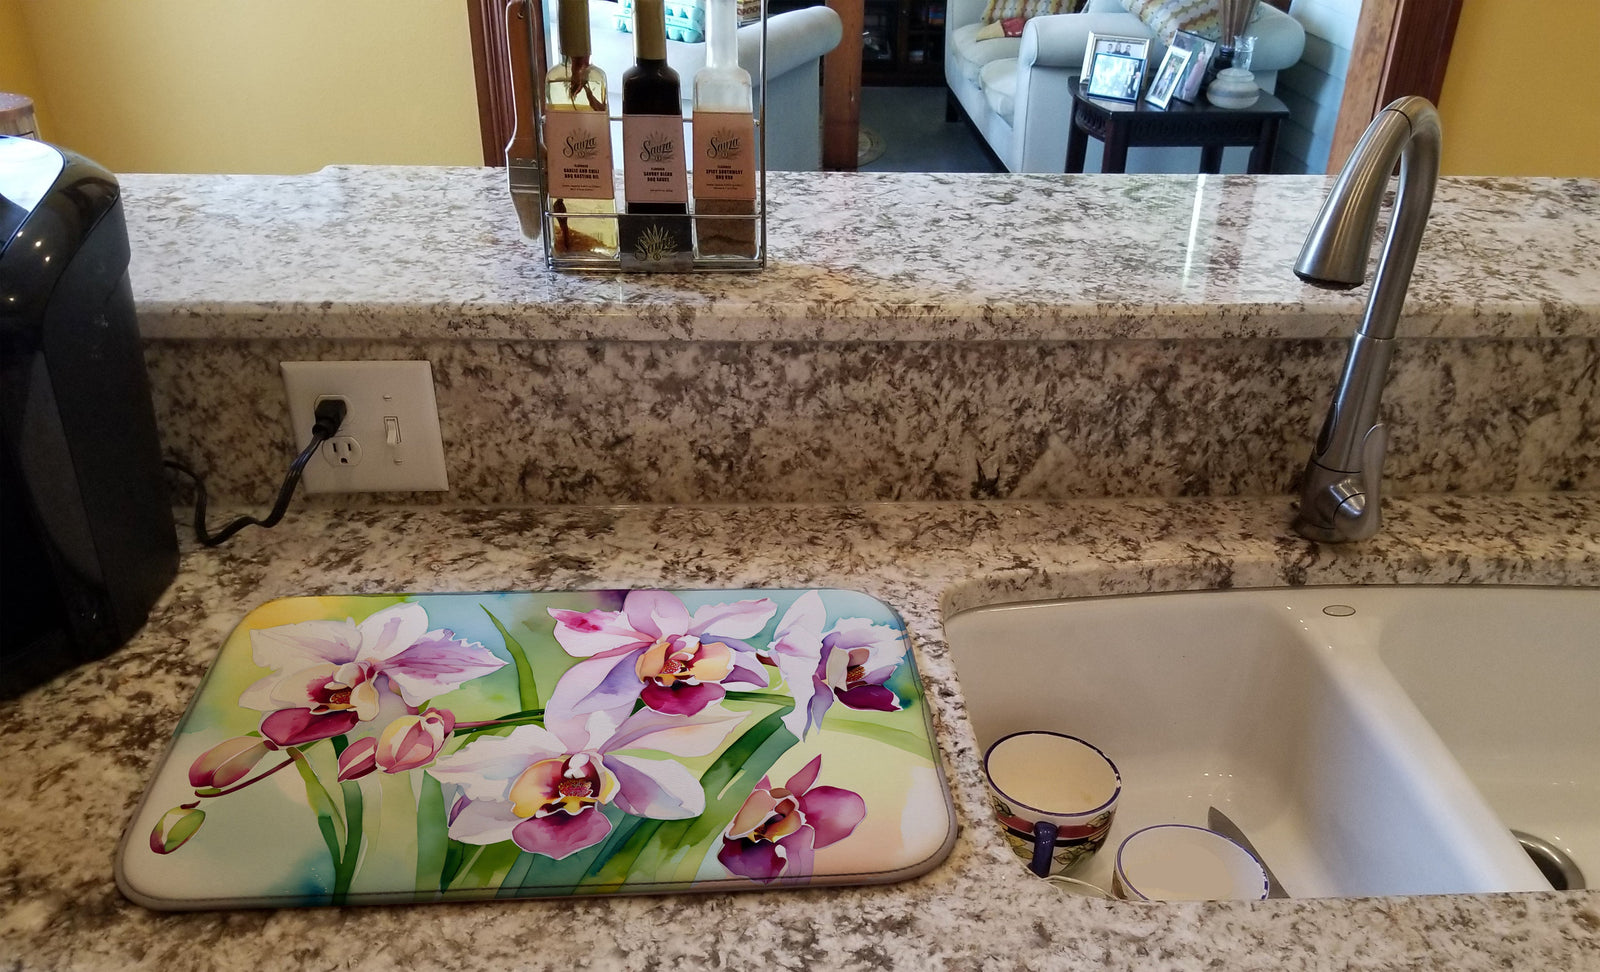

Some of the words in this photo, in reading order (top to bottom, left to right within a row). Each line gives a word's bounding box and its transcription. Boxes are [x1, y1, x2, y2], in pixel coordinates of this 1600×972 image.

[563, 136, 597, 158] Sauza
[640, 140, 674, 161] Sauza
[707, 137, 741, 158] Sauza
